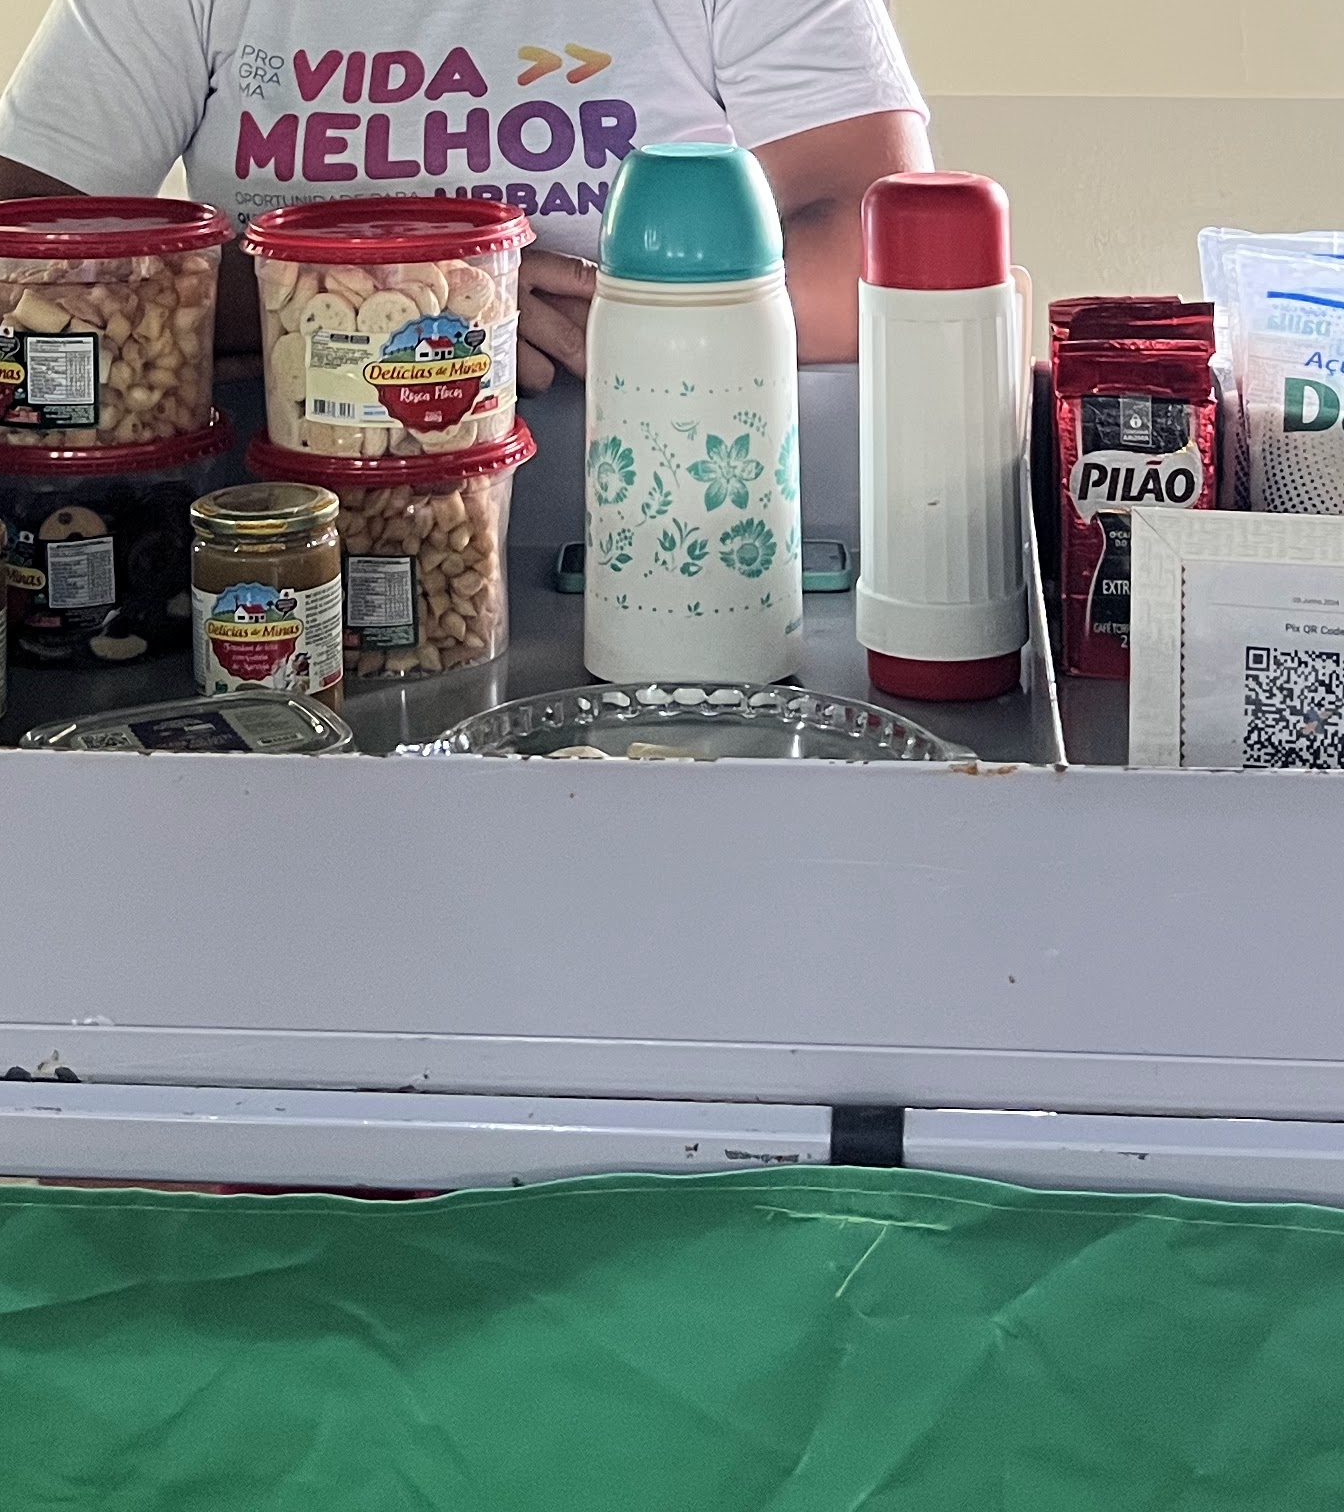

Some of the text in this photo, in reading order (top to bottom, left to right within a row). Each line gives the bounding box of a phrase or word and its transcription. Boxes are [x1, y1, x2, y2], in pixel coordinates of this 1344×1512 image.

[241, 44, 285, 70] PRO
[239, 62, 281, 86] GRA
[293, 46, 488, 104] VIDA
[238, 82, 265, 100] MA
[235, 99, 637, 182] MELHOR
[435, 366, 447, 376] de
[449, 359, 487, 377] Minas
[1078, 459, 1196, 504] PILÃO
[1102, 579, 1130, 595] EXTR
[262, 624, 299, 637] Minas
[1285, 623, 1344, 636] Pix QR Code
